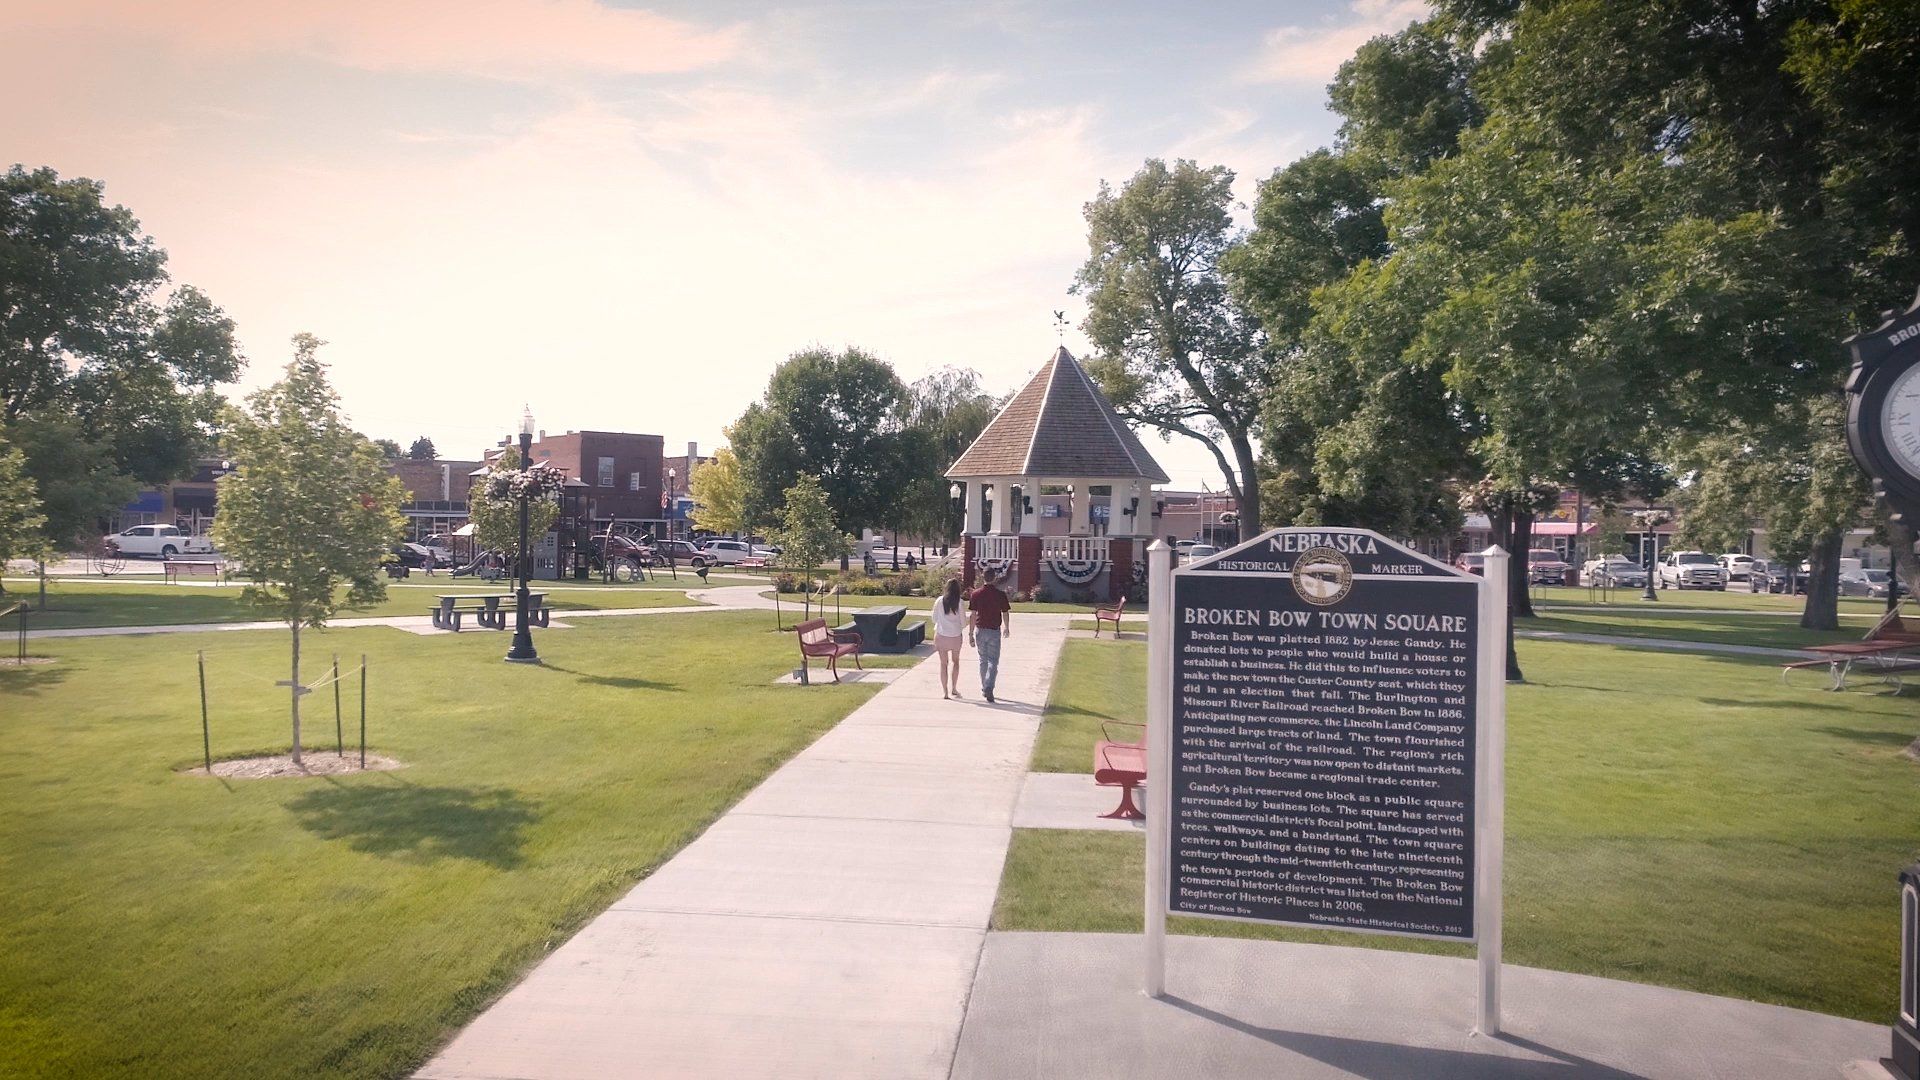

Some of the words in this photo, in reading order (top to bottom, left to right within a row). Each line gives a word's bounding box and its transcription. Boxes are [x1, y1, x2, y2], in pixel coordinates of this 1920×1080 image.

[1270, 534, 1378, 554] NEBRASKA
[1218, 560, 1290, 572] HISTORICAL
[1371, 564, 1424, 574] MARKER
[1184, 607, 1260, 625] BROKEN
[1268, 610, 1311, 626] BOW
[1318, 611, 1376, 629] TOWN
[1384, 614, 1466, 632] SQUARE
[1191, 630, 1228, 640] Broken
[1232, 631, 1253, 641] Bow
[1279, 634, 1320, 644] platted
[1325, 635, 1348, 645] 1882
[1353, 636, 1367, 647] by
[1369, 636, 1399, 646] Jesse
[1404, 638, 1444, 649] Gandy.
[1450, 639, 1465, 648] He
[1184, 644, 1226, 653] donated
[1229, 645, 1248, 655] lots
[1267, 648, 1302, 658] people
[1307, 649, 1328, 657] who
[1332, 650, 1364, 659] would
[1370, 650, 1398, 660] build
[1414, 652, 1447, 662] house
[1183, 658, 1228, 667] establish
[1240, 659, 1285, 669] business.
[1289, 660, 1302, 670] He
[1305, 661, 1321, 671] did
[1323, 662, 1345, 672] this
[1362, 664, 1413, 674] influence
[1415, 667, 1450, 676] voters
[1183, 670, 1209, 680] make
[1211, 672, 1228, 680] the
[1251, 673, 1276, 682] town
[1278, 674, 1295, 683] the
[1297, 675, 1333, 685] Custer
[1334, 676, 1375, 688] County
[1406, 680, 1437, 689] which
[1439, 681, 1464, 692] they
[1183, 683, 1200, 692] did
[1240, 686, 1284, 696] election
[1291, 688, 1314, 698] that
[1321, 690, 1342, 699] fall.
[1348, 690, 1370, 700] The
[1375, 691, 1437, 704] Burlington
[1444, 695, 1465, 704] and
[1183, 696, 1226, 707] Missouri
[1230, 698, 1259, 708] River
[1262, 700, 1308, 711] Railroad
[1311, 704, 1354, 713] reached
[1358, 704, 1396, 715] Broken
[1400, 706, 1421, 716] Bow
[1438, 708, 1464, 718] 1886.
[1183, 710, 1245, 723] Anticipating
[1324, 717, 1340, 726] the
[1343, 718, 1382, 728] Lincoln
[1384, 720, 1411, 730] Land
[1413, 721, 1464, 734] Company
[1183, 725, 1235, 734] purchased
[1238, 726, 1265, 738] large
[1267, 728, 1299, 738] tracts
[1316, 730, 1342, 740] land.
[1348, 732, 1370, 742] The
[1374, 734, 1401, 743] town
[1404, 735, 1464, 746] flourished
[1182, 738, 1204, 746] with
[1208, 738, 1225, 747] the
[1229, 741, 1265, 749] arrival
[1285, 742, 1302, 752] the
[1306, 744, 1355, 754] railroad.
[1362, 746, 1384, 756] The
[1390, 750, 1434, 759] region's
[1441, 751, 1464, 760] rich
[1182, 751, 1241, 761] agricultural
[1242, 753, 1291, 766] territory
[1334, 760, 1360, 769] open
[1375, 761, 1414, 771] distant
[1182, 764, 1201, 772] and
[1204, 764, 1241, 775] Broken
[1244, 766, 1265, 776] Bow
[1268, 768, 1307, 779] became
[1318, 773, 1364, 783] regional
[1366, 775, 1397, 785] trade
[1399, 778, 1439, 787] center.
[1188, 781, 1229, 793] Gandy's
[1232, 785, 1252, 795] plat
[1255, 788, 1302, 797] reserved
[1326, 791, 1356, 801] block
[1384, 795, 1420, 805] public
[1424, 799, 1463, 808] square
[1181, 796, 1241, 807] surrounded
[1244, 798, 1258, 809] by
[1263, 800, 1307, 811] business
[1310, 803, 1332, 813] lots.
[1336, 804, 1357, 814] The
[1360, 809, 1398, 818] square
[1402, 809, 1421, 819] has
[1426, 813, 1463, 822] served
[1192, 809, 1209, 818] the
[1211, 812, 1268, 822] commercial
[1269, 814, 1314, 825] district's
[1317, 817, 1343, 828] focal
[1377, 822, 1437, 836] landscaped
[1440, 827, 1463, 836] with
[1181, 836, 1220, 845] centers
[1241, 838, 1290, 852] buildings
[1294, 843, 1329, 855] dating
[1350, 847, 1368, 857] the
[1372, 848, 1394, 859] late
[1398, 852, 1462, 864] nineteenth
[1269, 828, 1288, 837] and
[1302, 830, 1361, 842] bandstand.
[1366, 834, 1388, 844] The
[1392, 837, 1420, 847] town
[1424, 841, 1463, 850] square
[1180, 849, 1219, 860] century
[1220, 851, 1260, 863] through
[1262, 854, 1278, 863] the
[1280, 856, 1353, 869] mid-twentieth
[1398, 866, 1464, 879] representing
[1180, 864, 1197, 873] the
[1200, 865, 1231, 875] town's
[1234, 869, 1274, 878] periods
[1293, 872, 1365, 884] development.
[1370, 876, 1391, 887] The
[1396, 878, 1436, 889] Broken
[1440, 881, 1462, 891] Bow
[1180, 876, 1239, 887] commercial
[1242, 879, 1283, 890] historic
[1284, 883, 1324, 894] district
[1347, 888, 1378, 899] listed
[1396, 892, 1414, 901] the
[1415, 893, 1462, 905] National
[1180, 887, 1223, 898] Register
[1239, 892, 1282, 904] Historic
[1285, 896, 1319, 907] Places
[1335, 900, 1364, 911] 2006.
